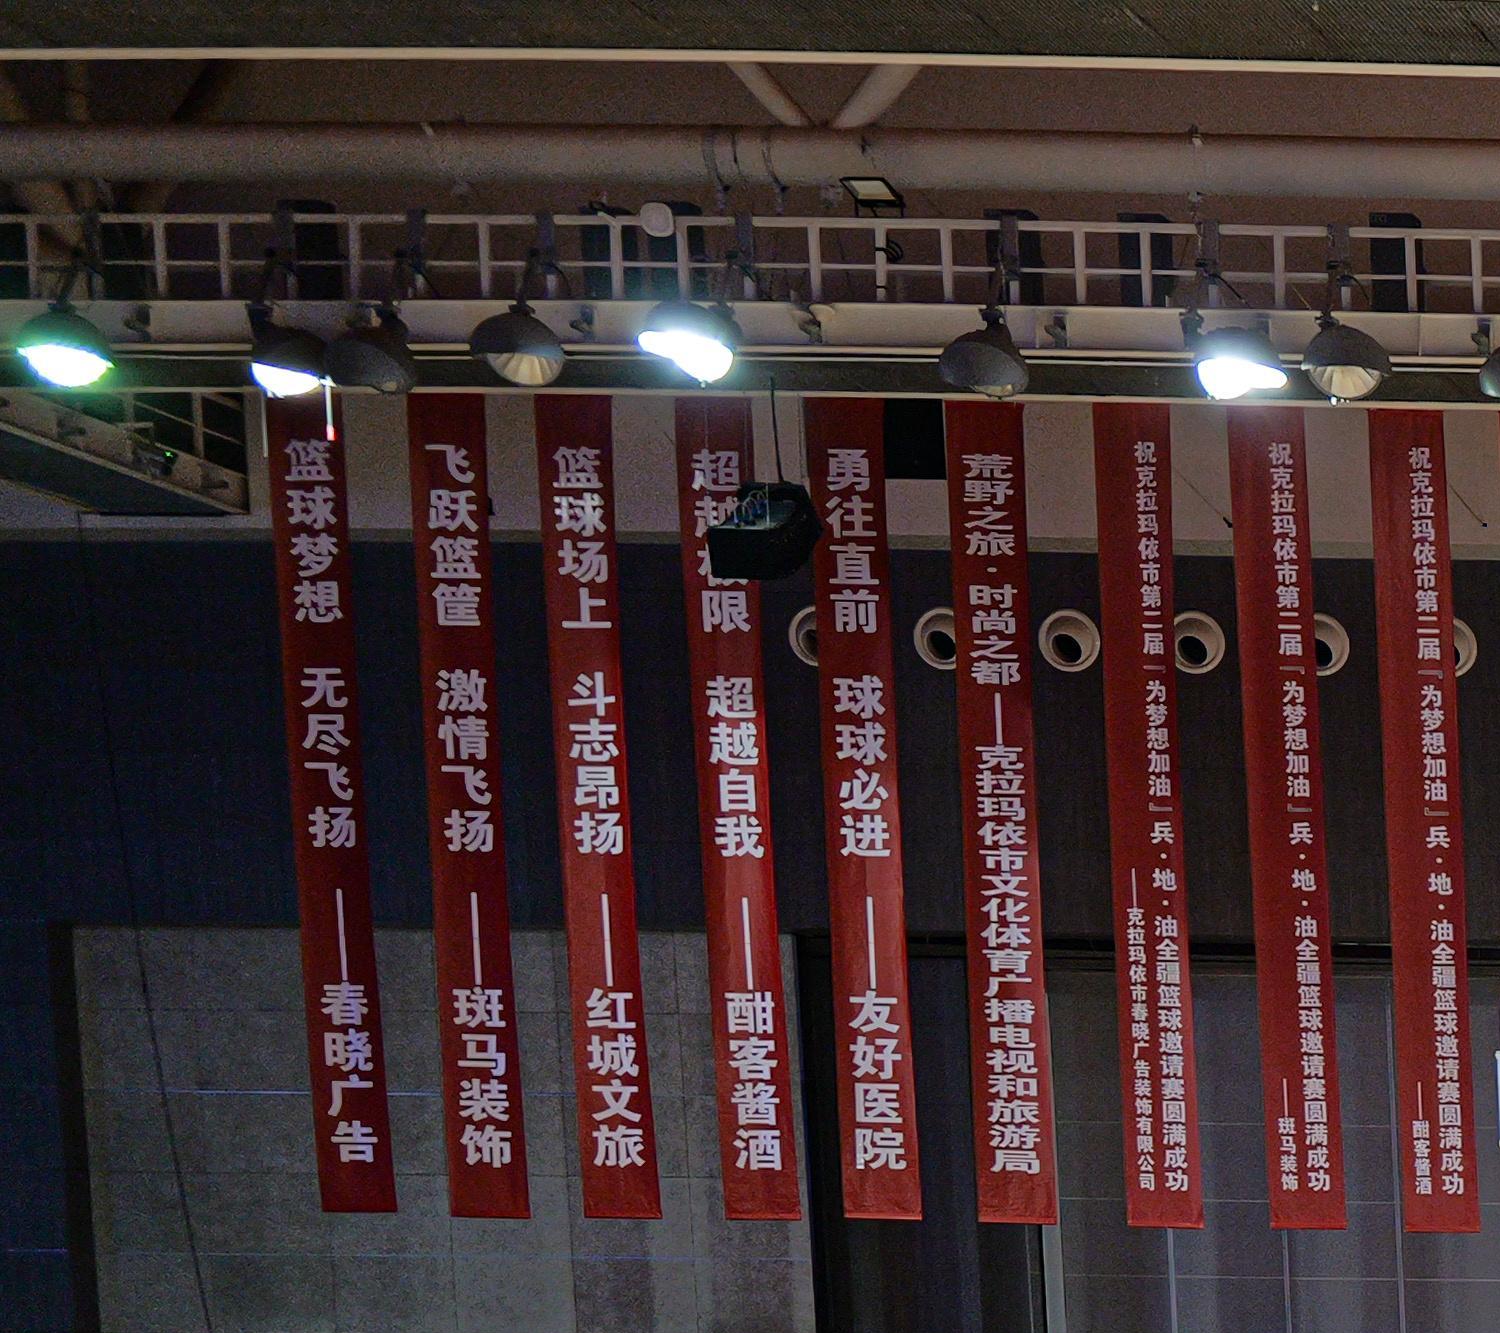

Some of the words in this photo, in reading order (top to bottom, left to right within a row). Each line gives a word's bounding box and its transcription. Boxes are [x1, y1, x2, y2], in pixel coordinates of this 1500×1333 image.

[283, 438, 344, 624] 篮球梦想
[425, 445, 483, 628] 飞跃篮筐
[553, 448, 612, 631] 篮球场上
[824, 448, 879, 635] 勇往直前
[301, 667, 357, 849] 无尽飞扬
[436, 668, 494, 854] 激情飞扬
[569, 672, 624, 855] 斗志昂扬
[706, 675, 765, 859] 超越自我
[833, 675, 890, 858] 球球必进
